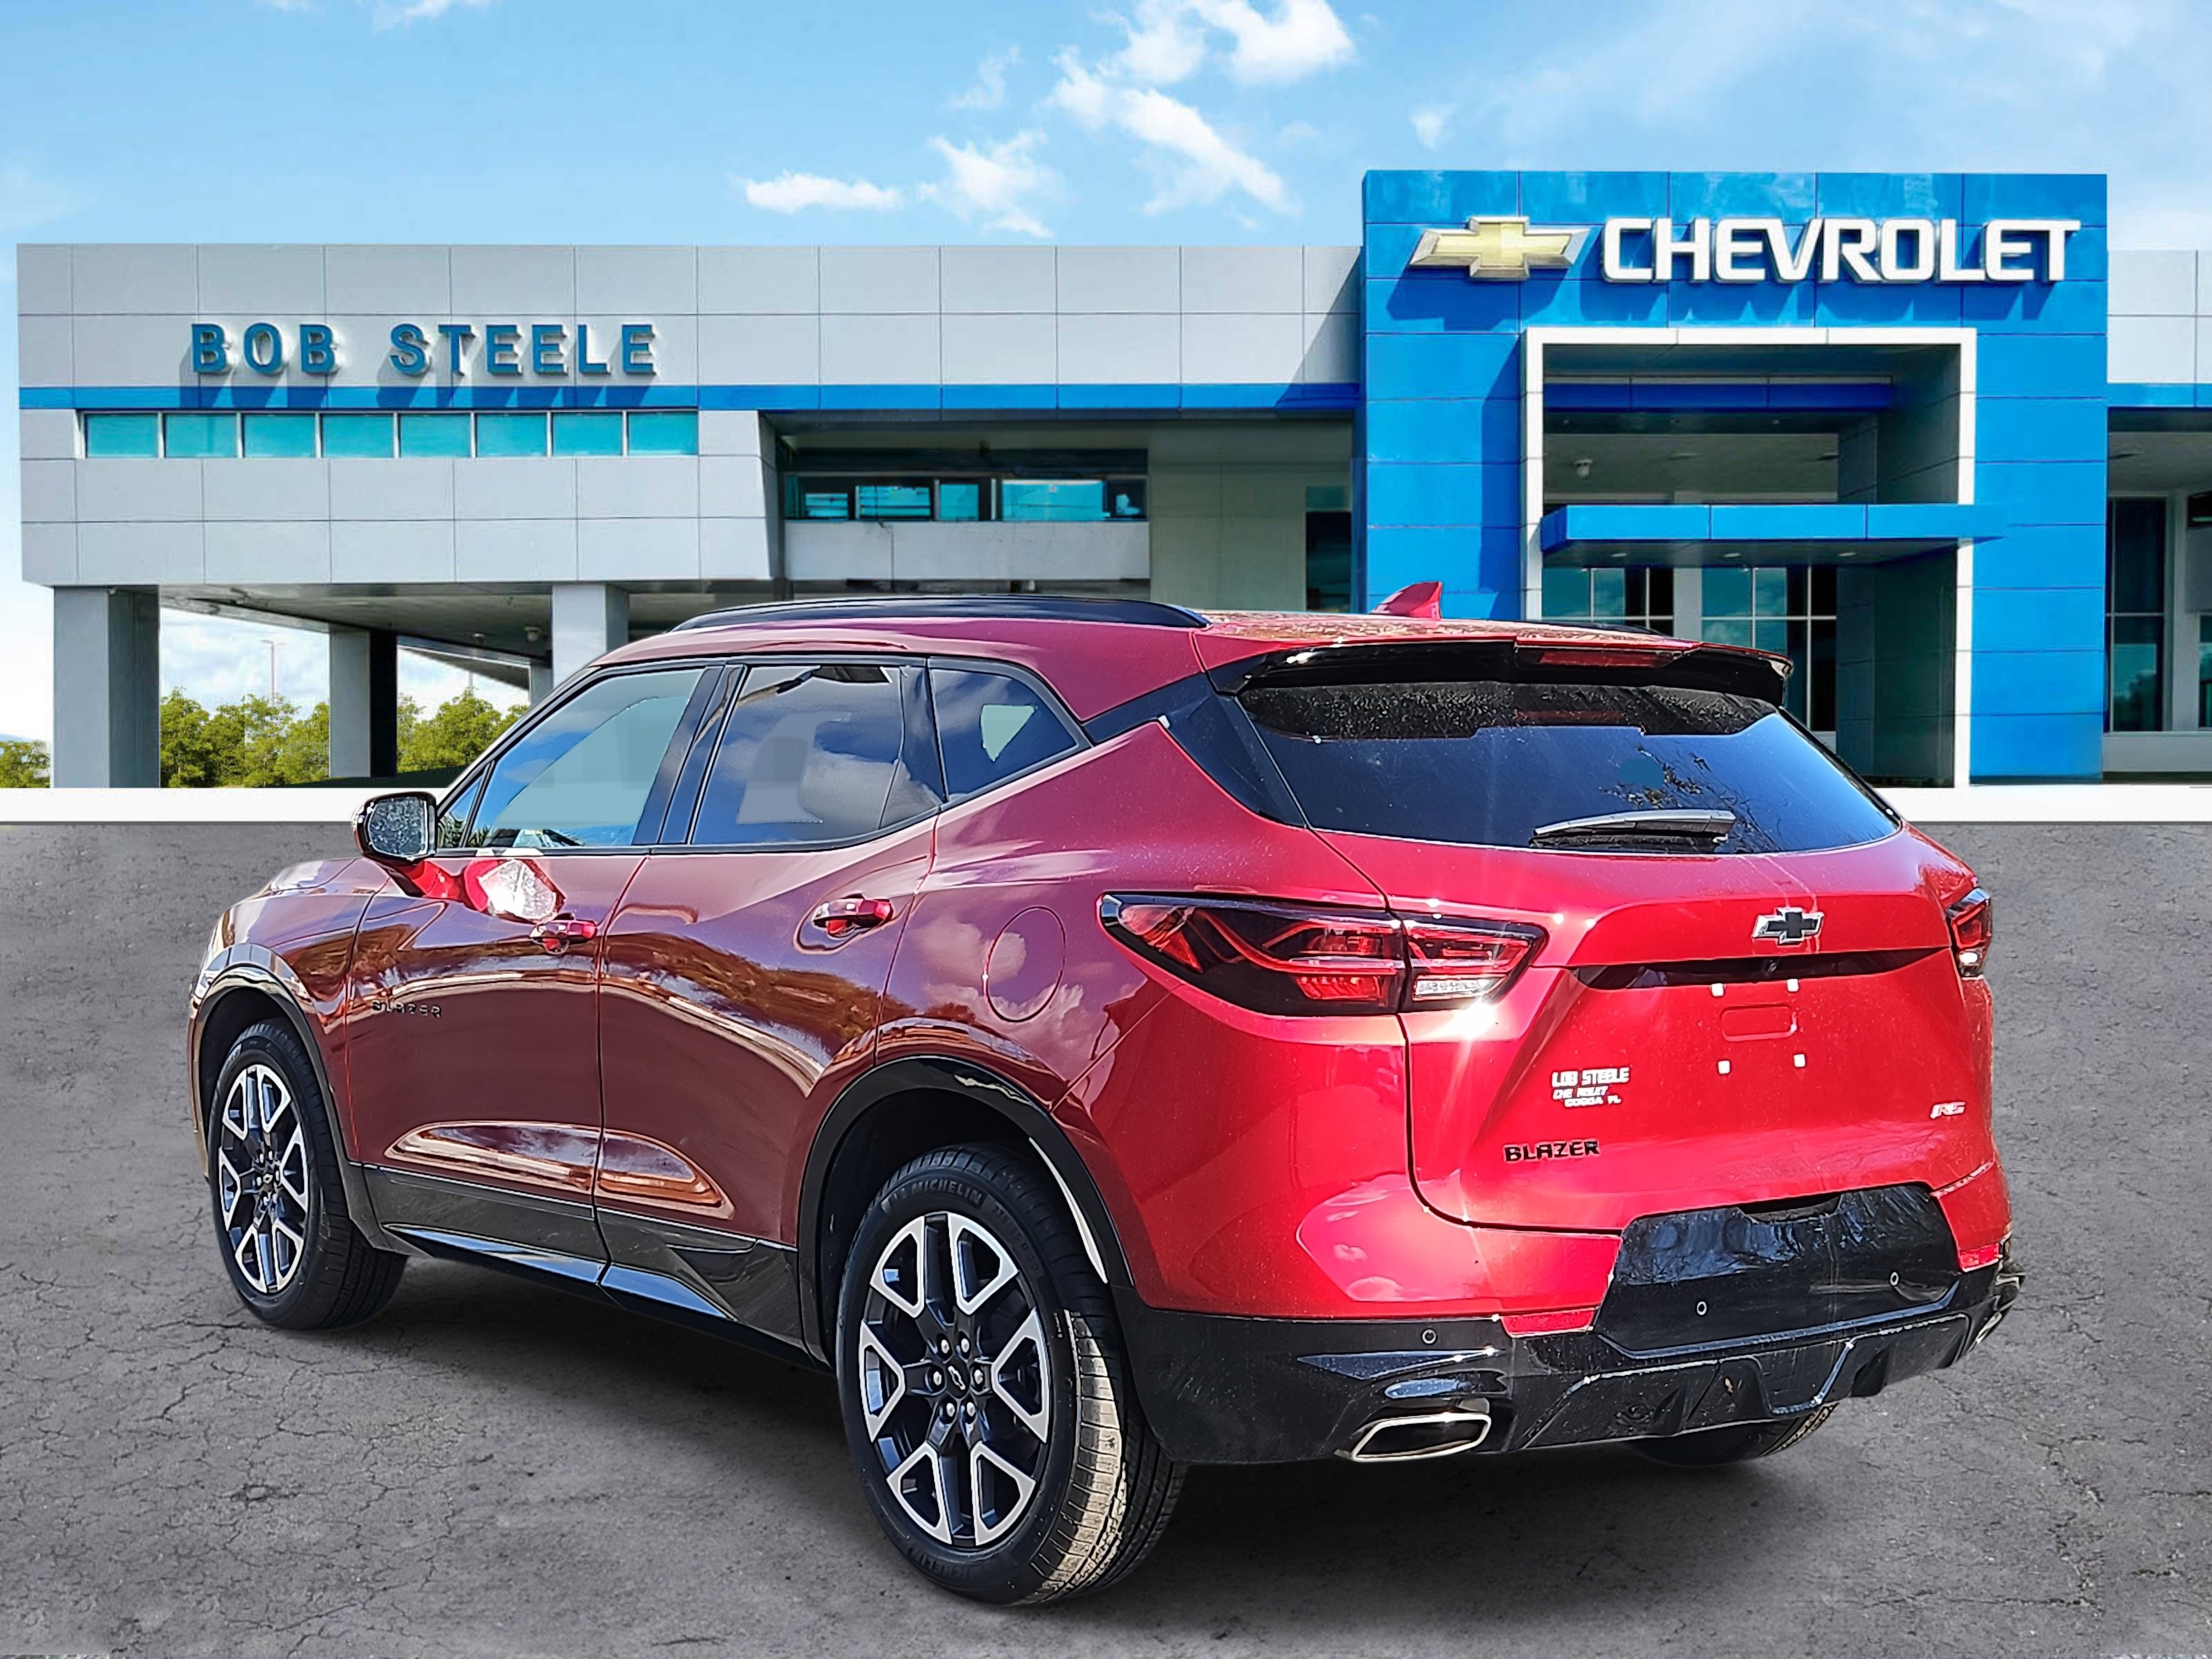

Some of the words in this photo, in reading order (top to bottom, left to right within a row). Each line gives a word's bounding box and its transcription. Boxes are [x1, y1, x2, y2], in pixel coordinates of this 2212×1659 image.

[1602, 218, 2081, 283] CHEVROLET
[191, 322, 336, 374] BOB
[390, 323, 656, 374] STEELE
[1504, 1139, 1600, 1162] BLAZER
[911, 1178, 982, 1204] MICHELIN
